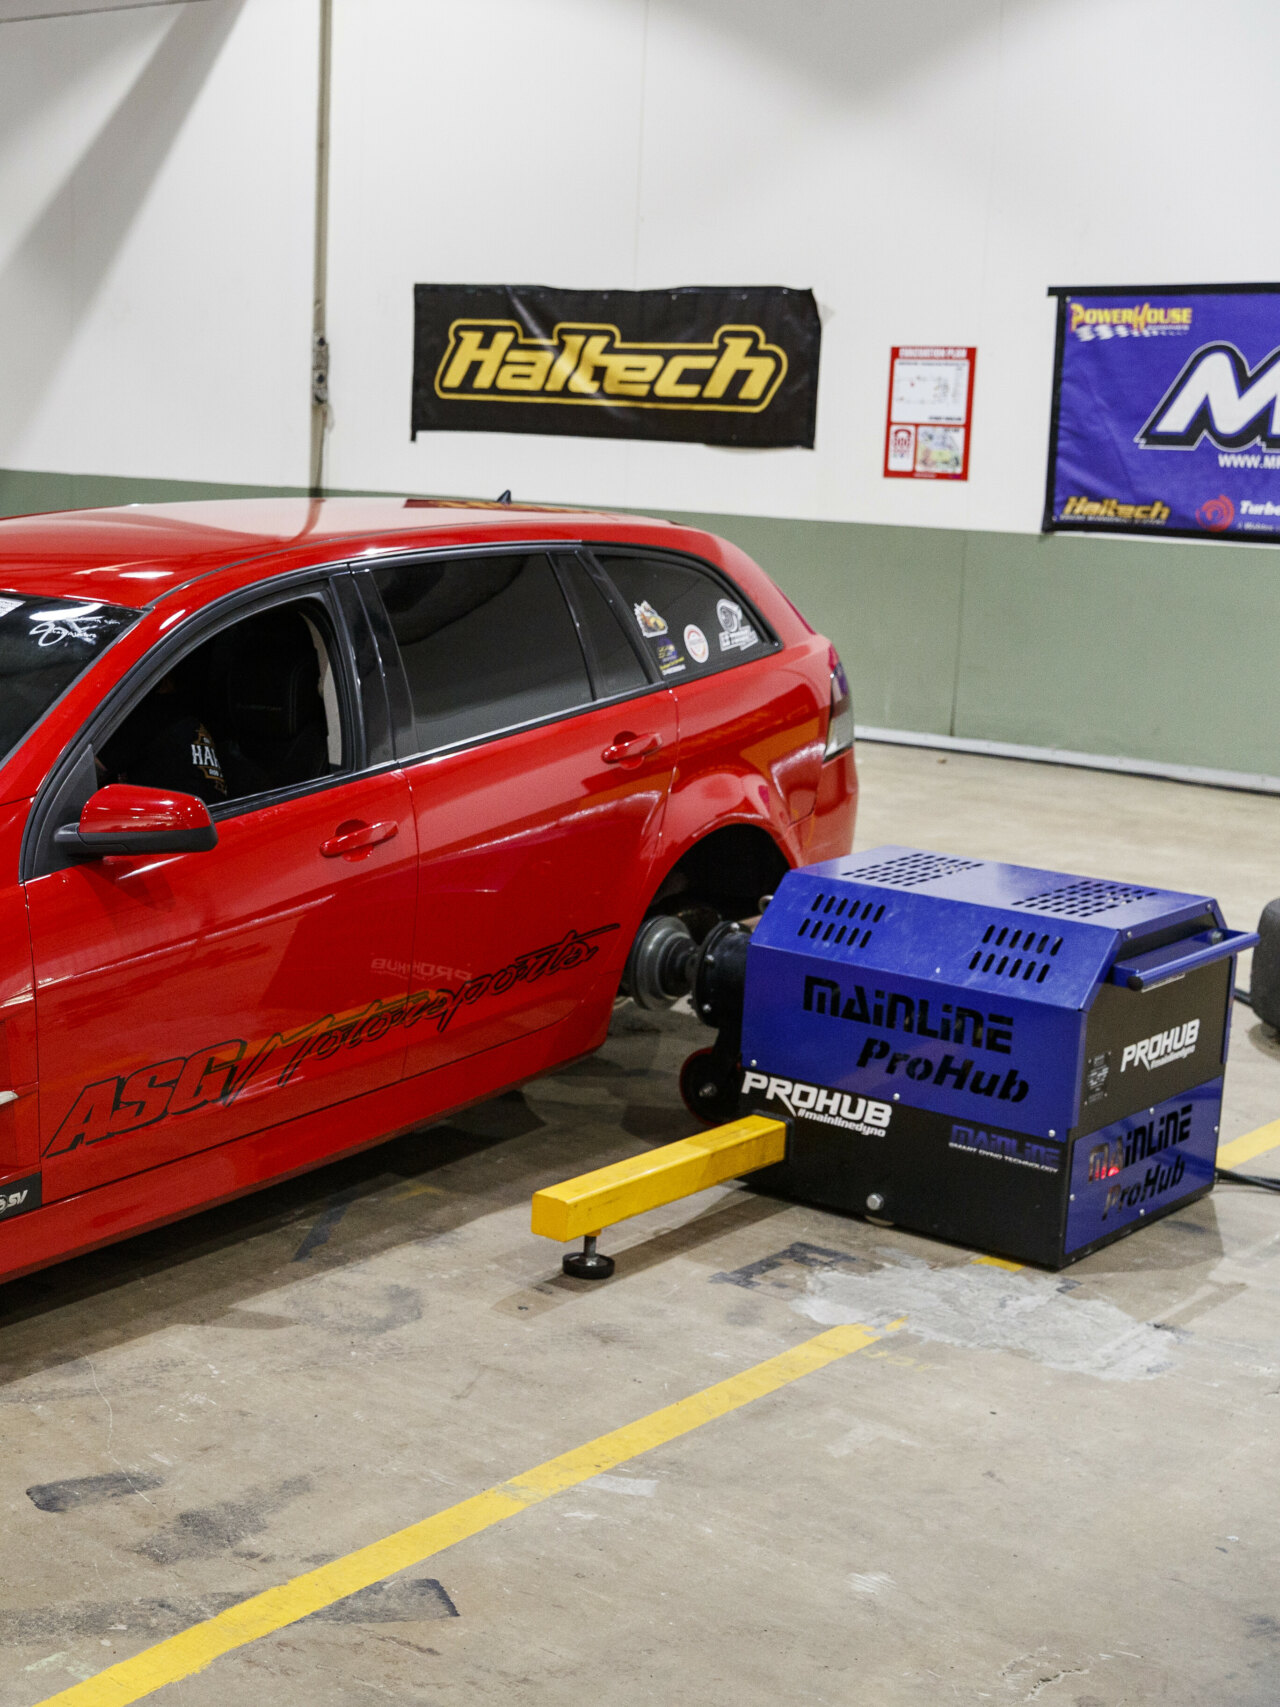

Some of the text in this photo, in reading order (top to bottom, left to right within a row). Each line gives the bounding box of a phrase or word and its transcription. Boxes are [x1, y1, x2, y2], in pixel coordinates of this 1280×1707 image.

[441, 330, 777, 400] Haltech
[1148, 350, 1280, 437] M
[1063, 496, 1171, 521] Haltech
[856, 1037, 1030, 1103] ProHub
[1120, 1018, 1200, 1073] PROHUB
[42, 1039, 248, 1159] ASG
[741, 1071, 893, 1128] PROHUB
[797, 1107, 887, 1138] #mainlinedyno
[1102, 1154, 1185, 1221] ProHub
